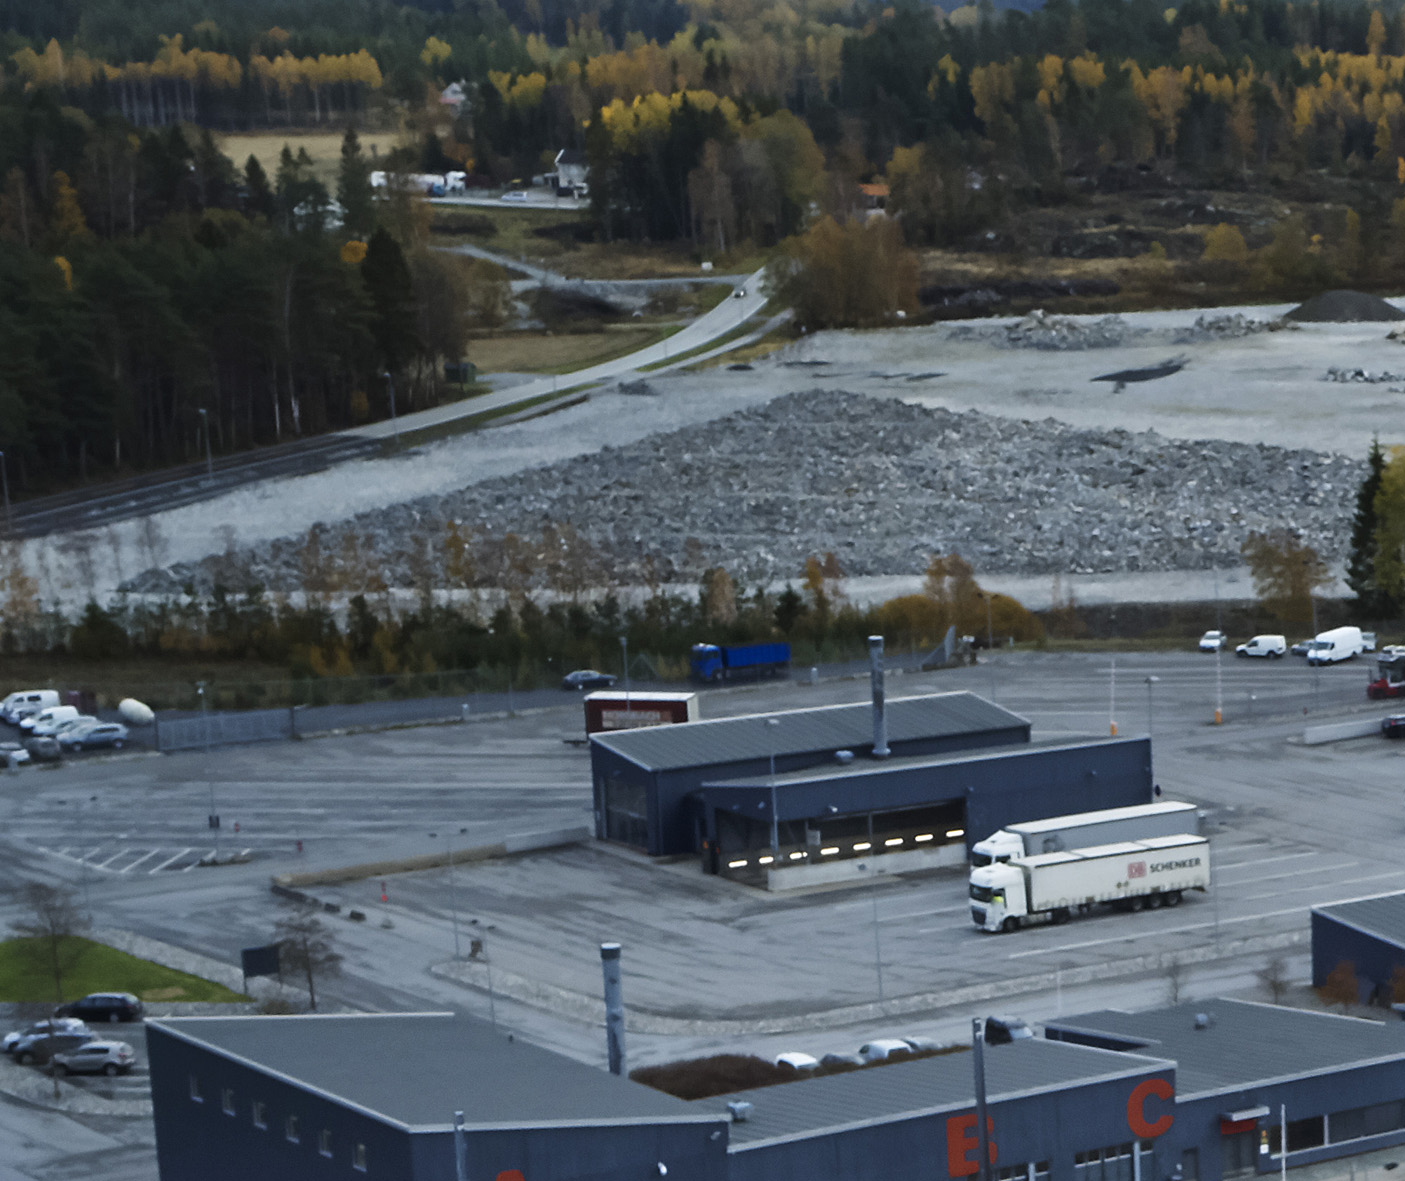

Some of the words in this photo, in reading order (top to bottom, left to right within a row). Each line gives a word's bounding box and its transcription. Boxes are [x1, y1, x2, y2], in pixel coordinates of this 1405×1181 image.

[1150, 858, 1201, 873] SCHENKER
[1127, 1078, 1175, 1138] C
[946, 1113, 998, 1178] B
